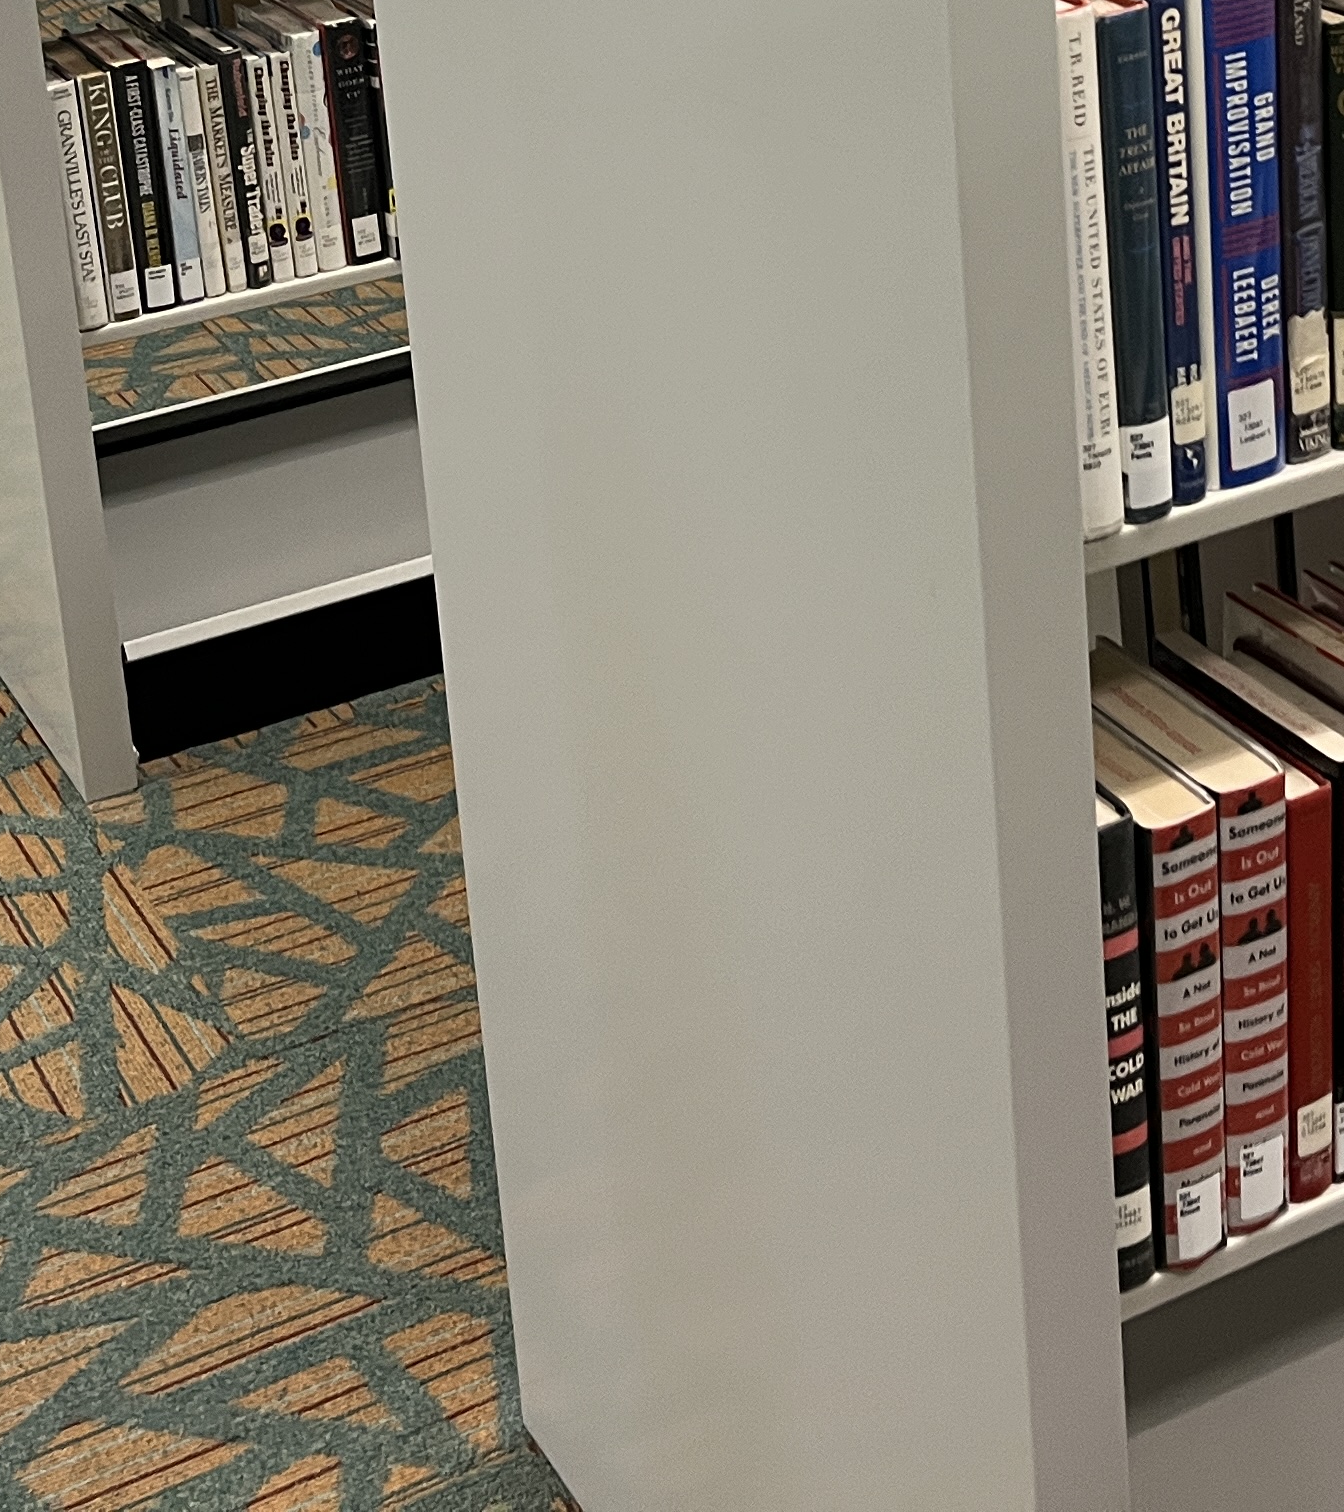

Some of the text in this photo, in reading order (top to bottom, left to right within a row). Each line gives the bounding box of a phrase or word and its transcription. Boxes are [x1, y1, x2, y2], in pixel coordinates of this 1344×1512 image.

[251, 65, 269, 116] Changing
[278, 60, 294, 110] Changing
[1068, 74, 1089, 128] REID
[1157, 7, 1192, 226] GREAT BRITAIN
[1215, 51, 1260, 217] IMPROVISATION
[1249, 92, 1279, 162] GRAND
[86, 81, 125, 229] KING CLUB
[165, 127, 187, 199] Liquidated
[204, 76, 238, 230] THE MARKET'S MEASURE
[238, 143, 259, 186] Super
[55, 109, 91, 248] GRANVILLE'S LAST
[1081, 145, 1109, 382] THE UNITED STATES OF
[1228, 266, 1262, 362] LEEBAERT
[1256, 273, 1283, 341] DEREK
[1257, 847, 1279, 864] Out
[1189, 880, 1212, 898] Out
[1231, 882, 1269, 905] to Get
[1182, 916, 1202, 934] Get
[1248, 953, 1256, 964] A
[1111, 1006, 1138, 1031] THE
[1183, 988, 1190, 999] A
[1239, 1010, 1274, 1030] History
[1174, 1046, 1211, 1067] History
[1241, 1044, 1264, 1061] Cold
[1111, 1078, 1143, 1105] WAR
